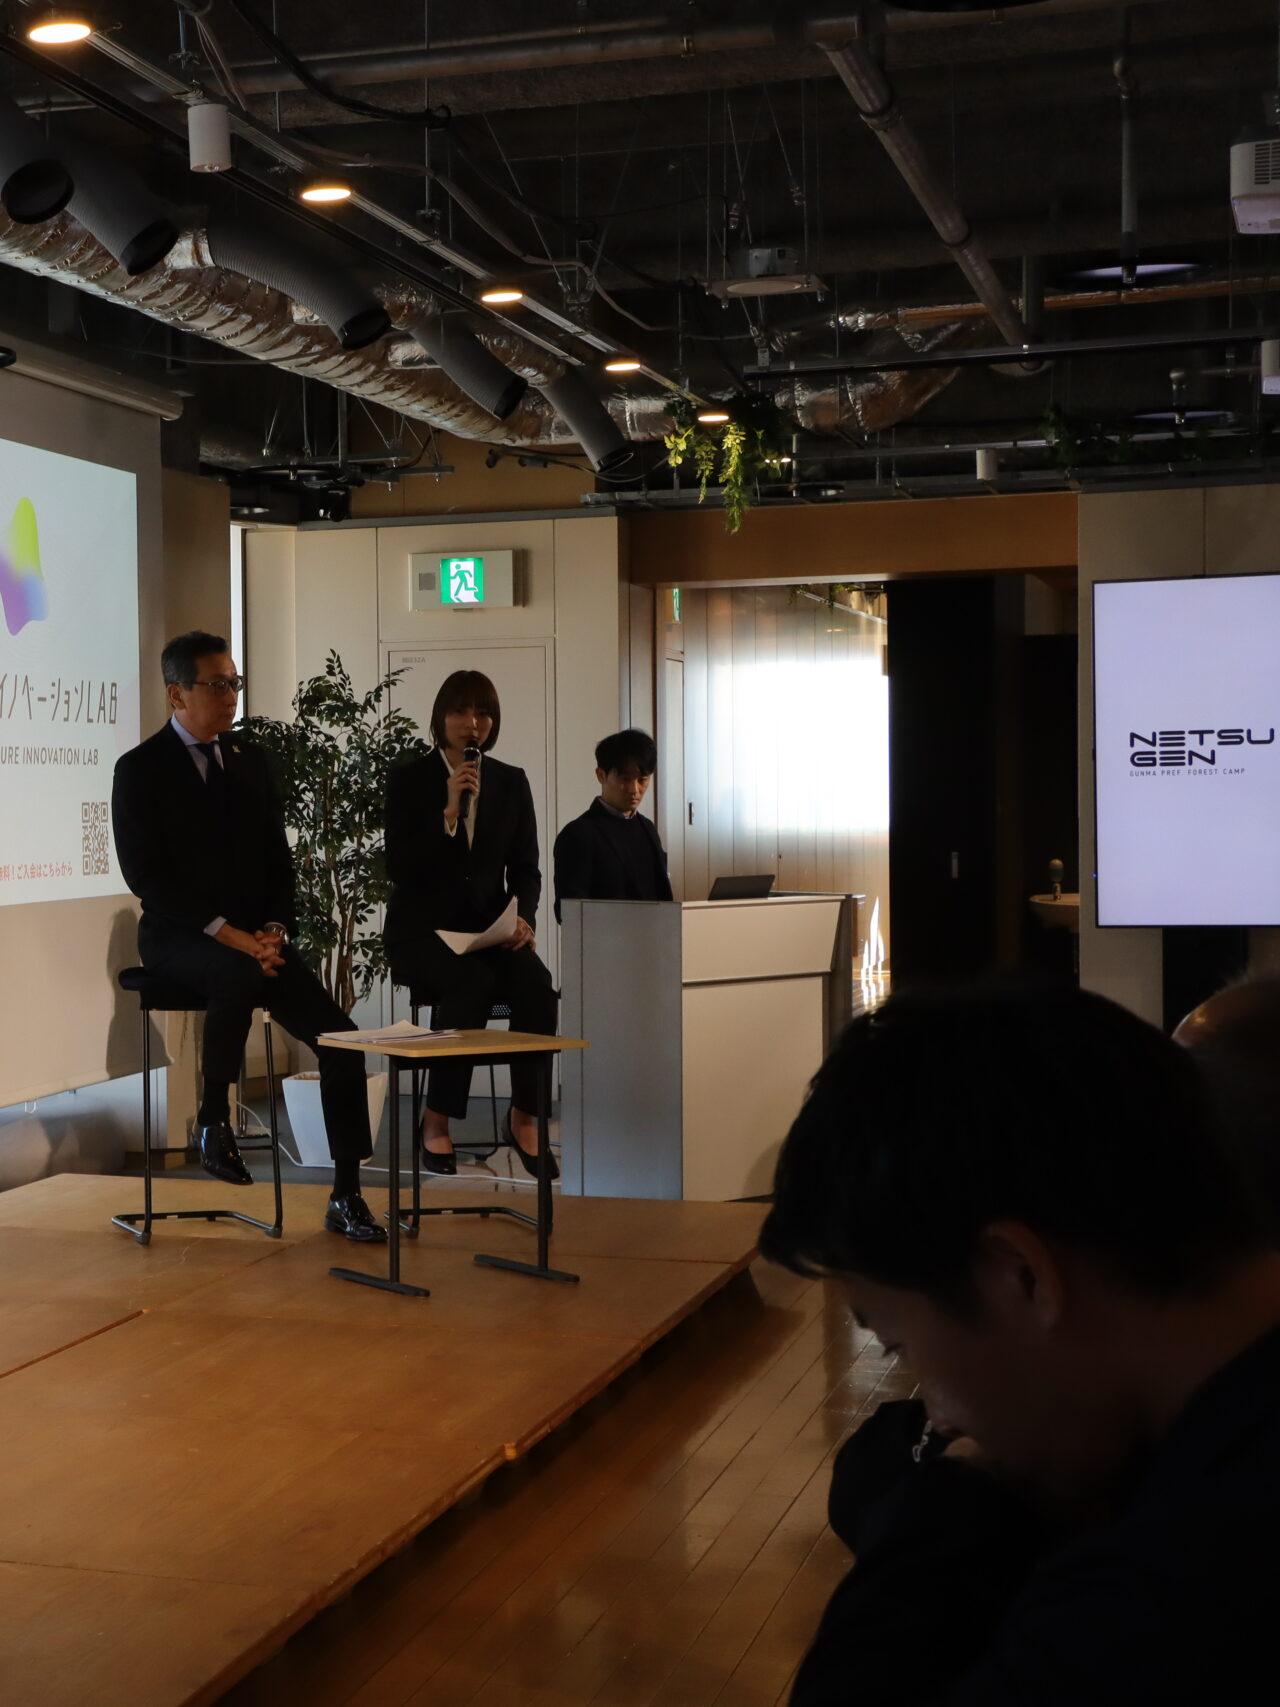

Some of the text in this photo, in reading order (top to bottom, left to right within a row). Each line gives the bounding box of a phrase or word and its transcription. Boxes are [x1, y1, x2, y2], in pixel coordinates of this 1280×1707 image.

[1129, 727, 1275, 748] NETSU
[22, 747, 80, 766] INNOVATION
[82, 748, 99, 766] LAB
[1129, 749, 1216, 768] GEN
[1188, 768, 1219, 776] FOREST
[1223, 767, 1245, 775] CAMP
